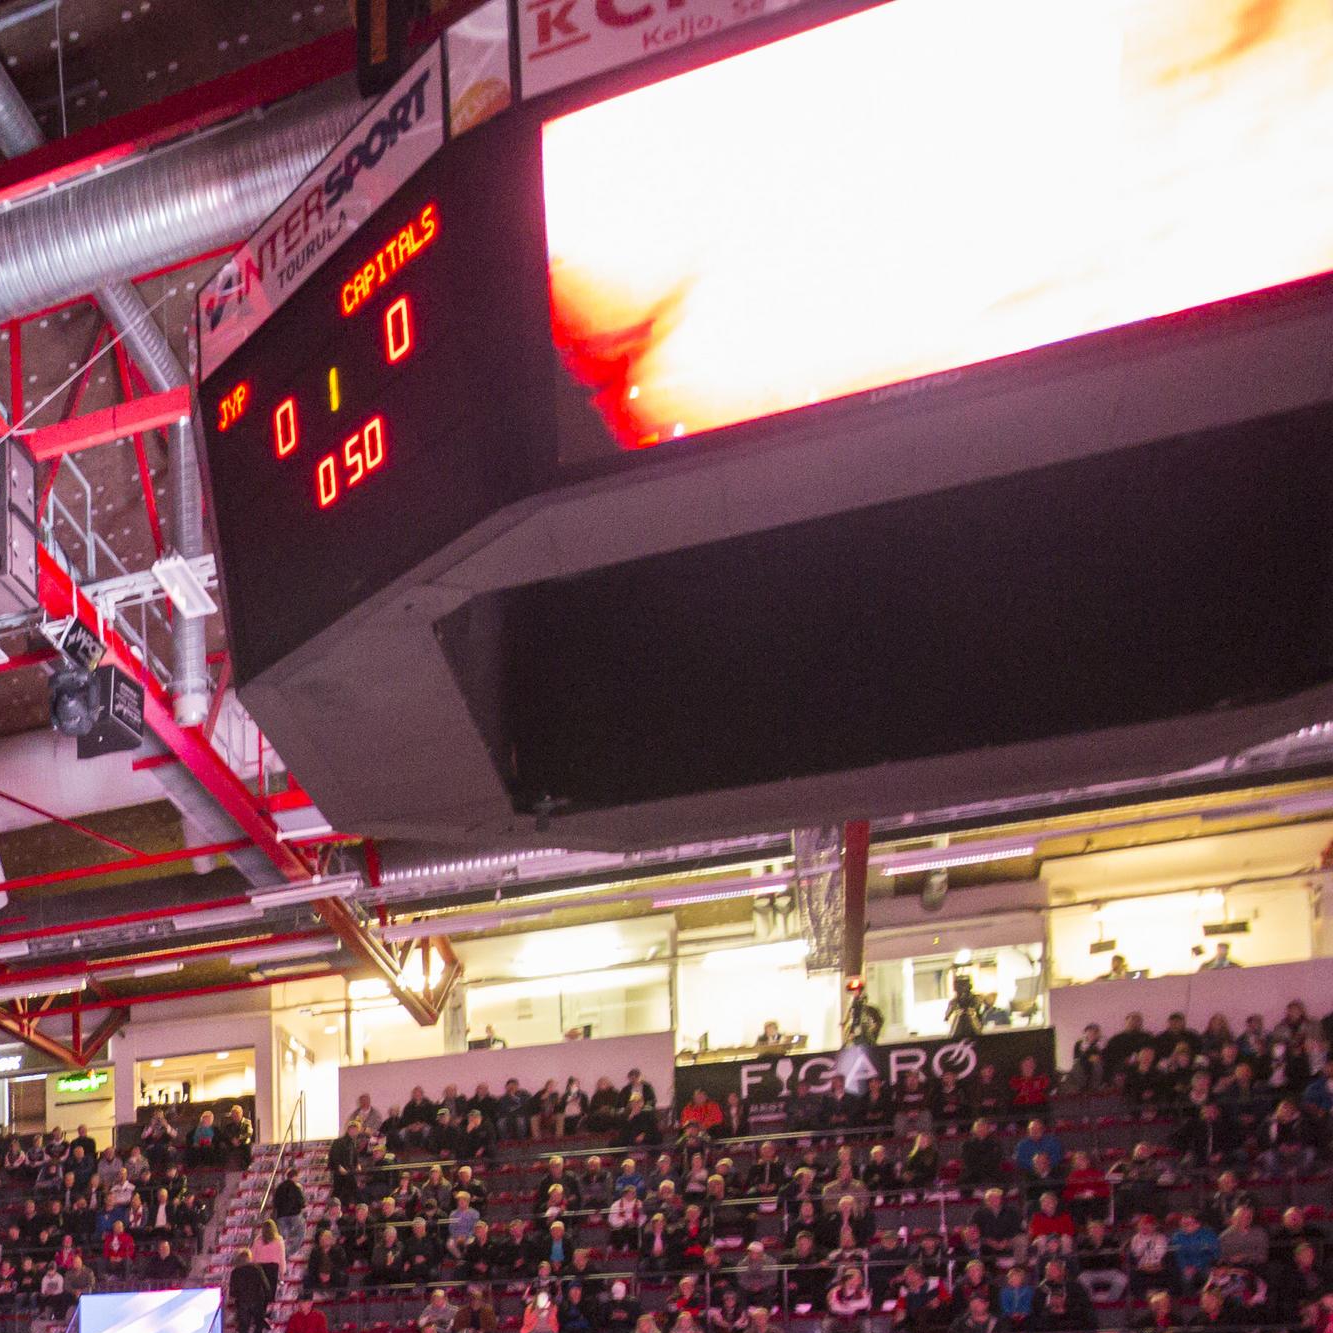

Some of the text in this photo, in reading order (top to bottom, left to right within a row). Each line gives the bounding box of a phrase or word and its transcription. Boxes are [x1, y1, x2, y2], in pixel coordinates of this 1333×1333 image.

[342, 204, 436, 315] CAPITALS
[386, 298, 410, 361] 0
[218, 385, 246, 431] JYP
[275, 399, 296, 456] 0
